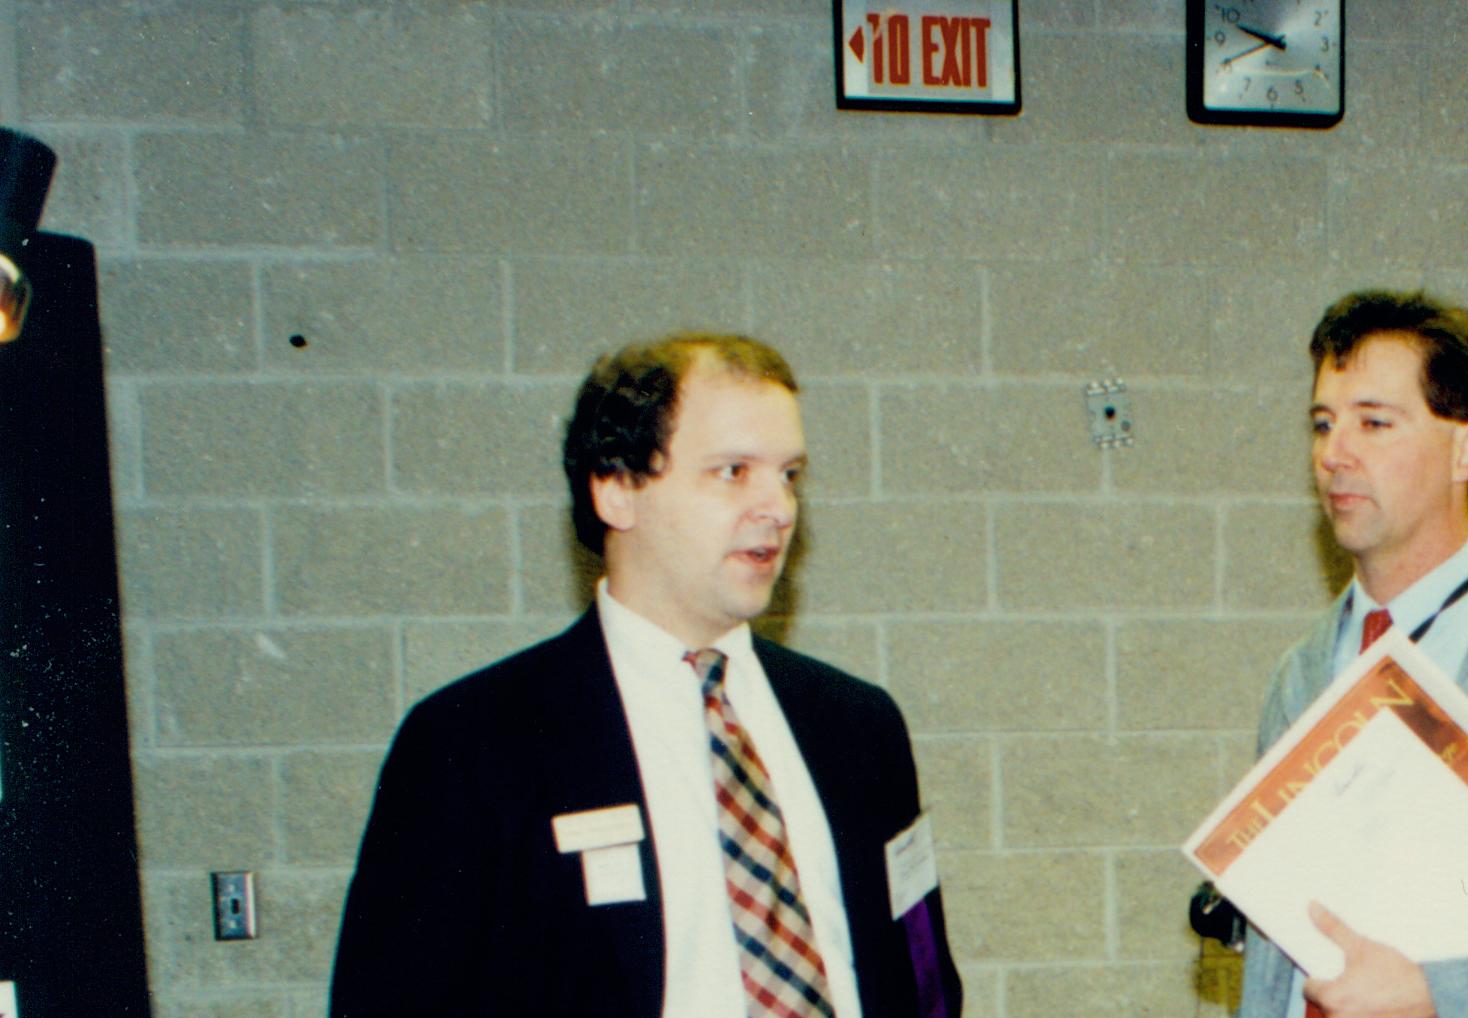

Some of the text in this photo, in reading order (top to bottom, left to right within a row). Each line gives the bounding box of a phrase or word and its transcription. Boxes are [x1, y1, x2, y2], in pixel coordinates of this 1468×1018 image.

[1221, 7, 1240, 24] 10
[1214, 31, 1226, 47] 9
[1321, 35, 1330, 53] 3
[866, 13, 992, 88] TO EXIT
[1266, 85, 1278, 102] 6
[1226, 819, 1266, 850] THE
